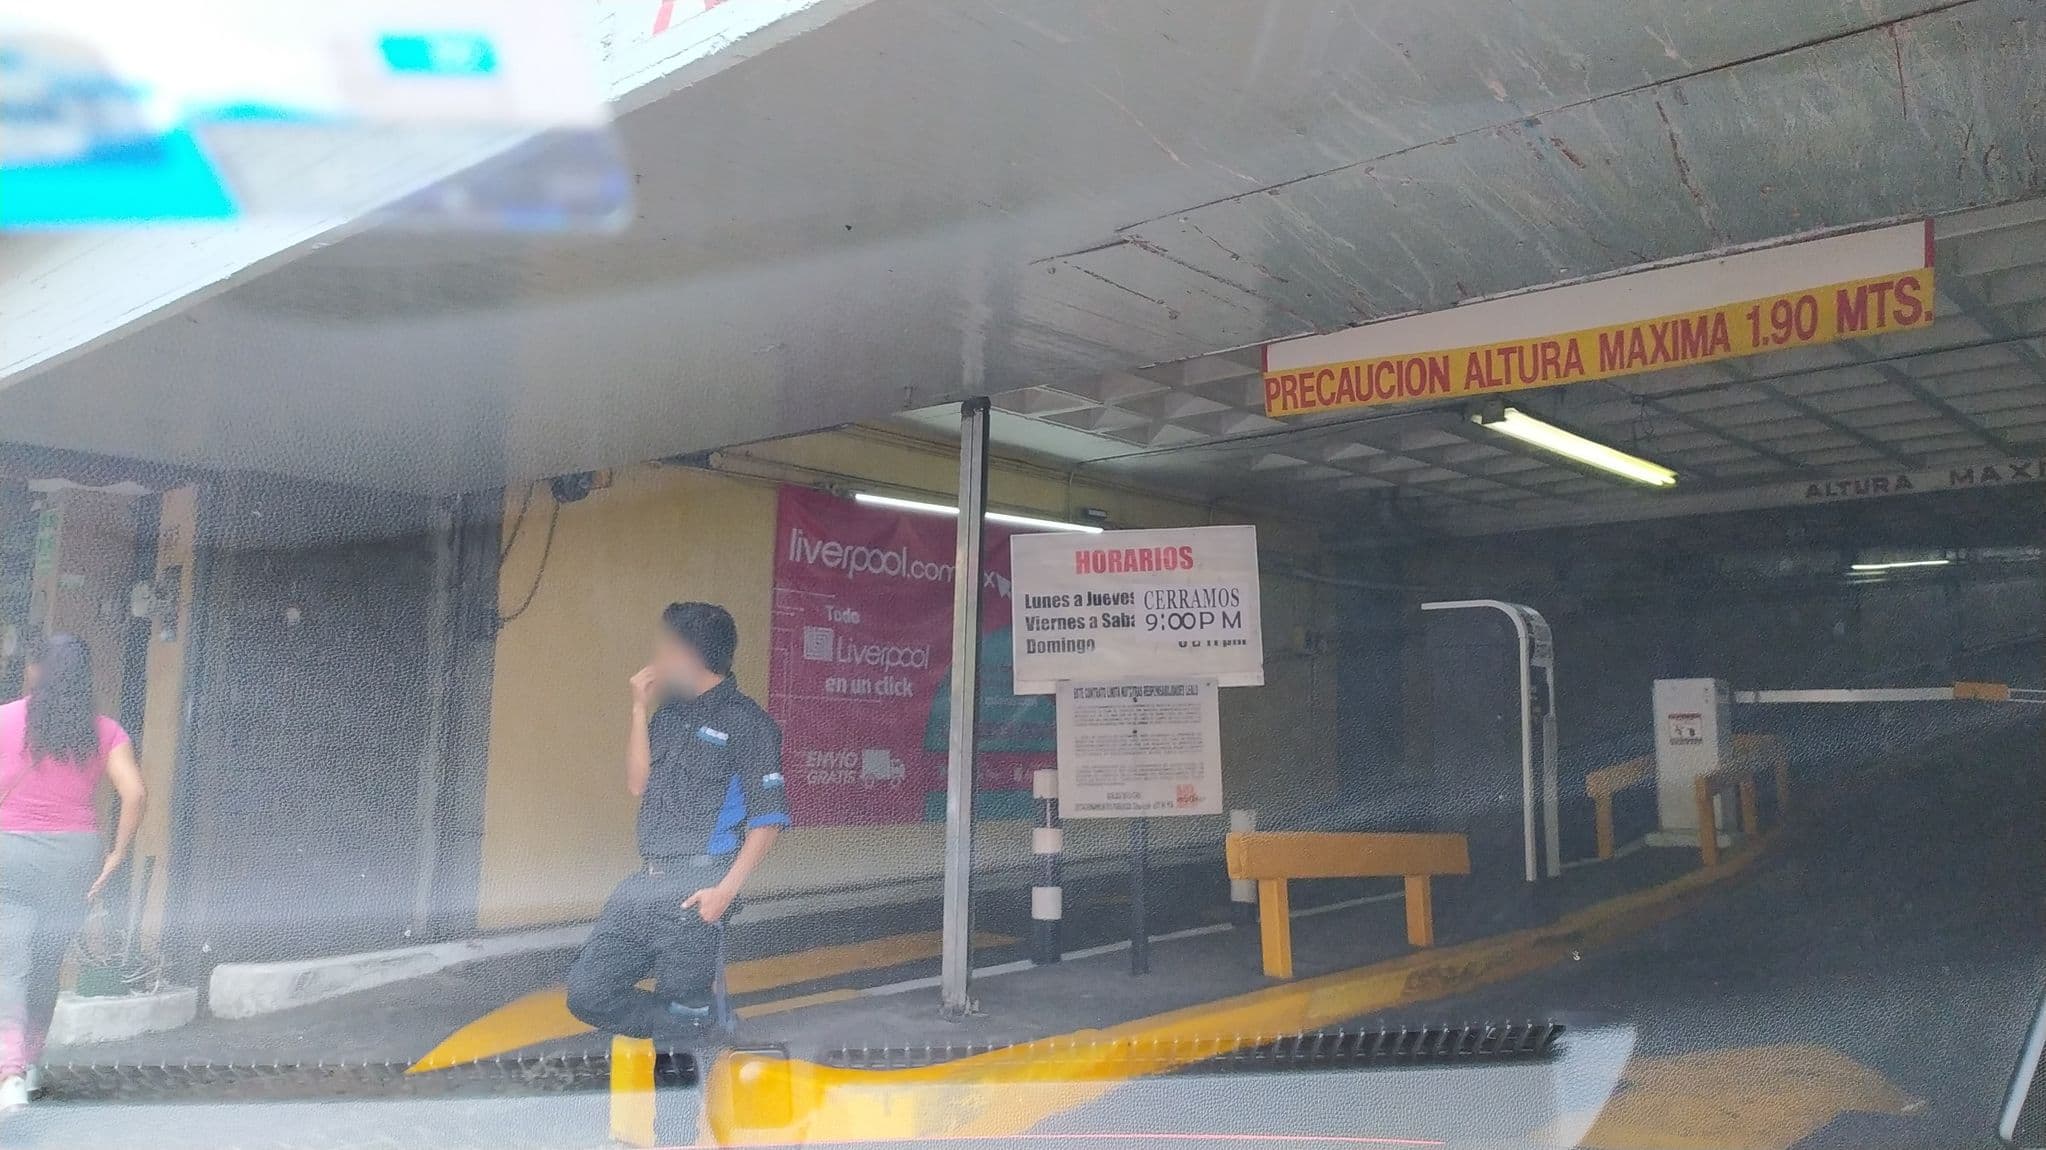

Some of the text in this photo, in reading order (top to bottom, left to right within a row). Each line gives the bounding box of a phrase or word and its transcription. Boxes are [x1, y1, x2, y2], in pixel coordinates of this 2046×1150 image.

[1265, 276, 1934, 412] PRECAUCION ALTURA MAXIMA 1.90 MTS.
[1806, 475, 1913, 498] ALTURA
[1075, 546, 1194, 575] HORARIOS
[1025, 594, 1070, 609] Lunes
[1074, 595, 1083, 607] a
[1144, 588, 1240, 610] CERRAMOS
[825, 605, 860, 624] Todo
[1025, 614, 1085, 632] Viernes
[1089, 617, 1098, 629] a
[837, 636, 930, 672] Liverpool
[1026, 637, 1095, 655] Domingo
[825, 676, 913, 697] en un click
